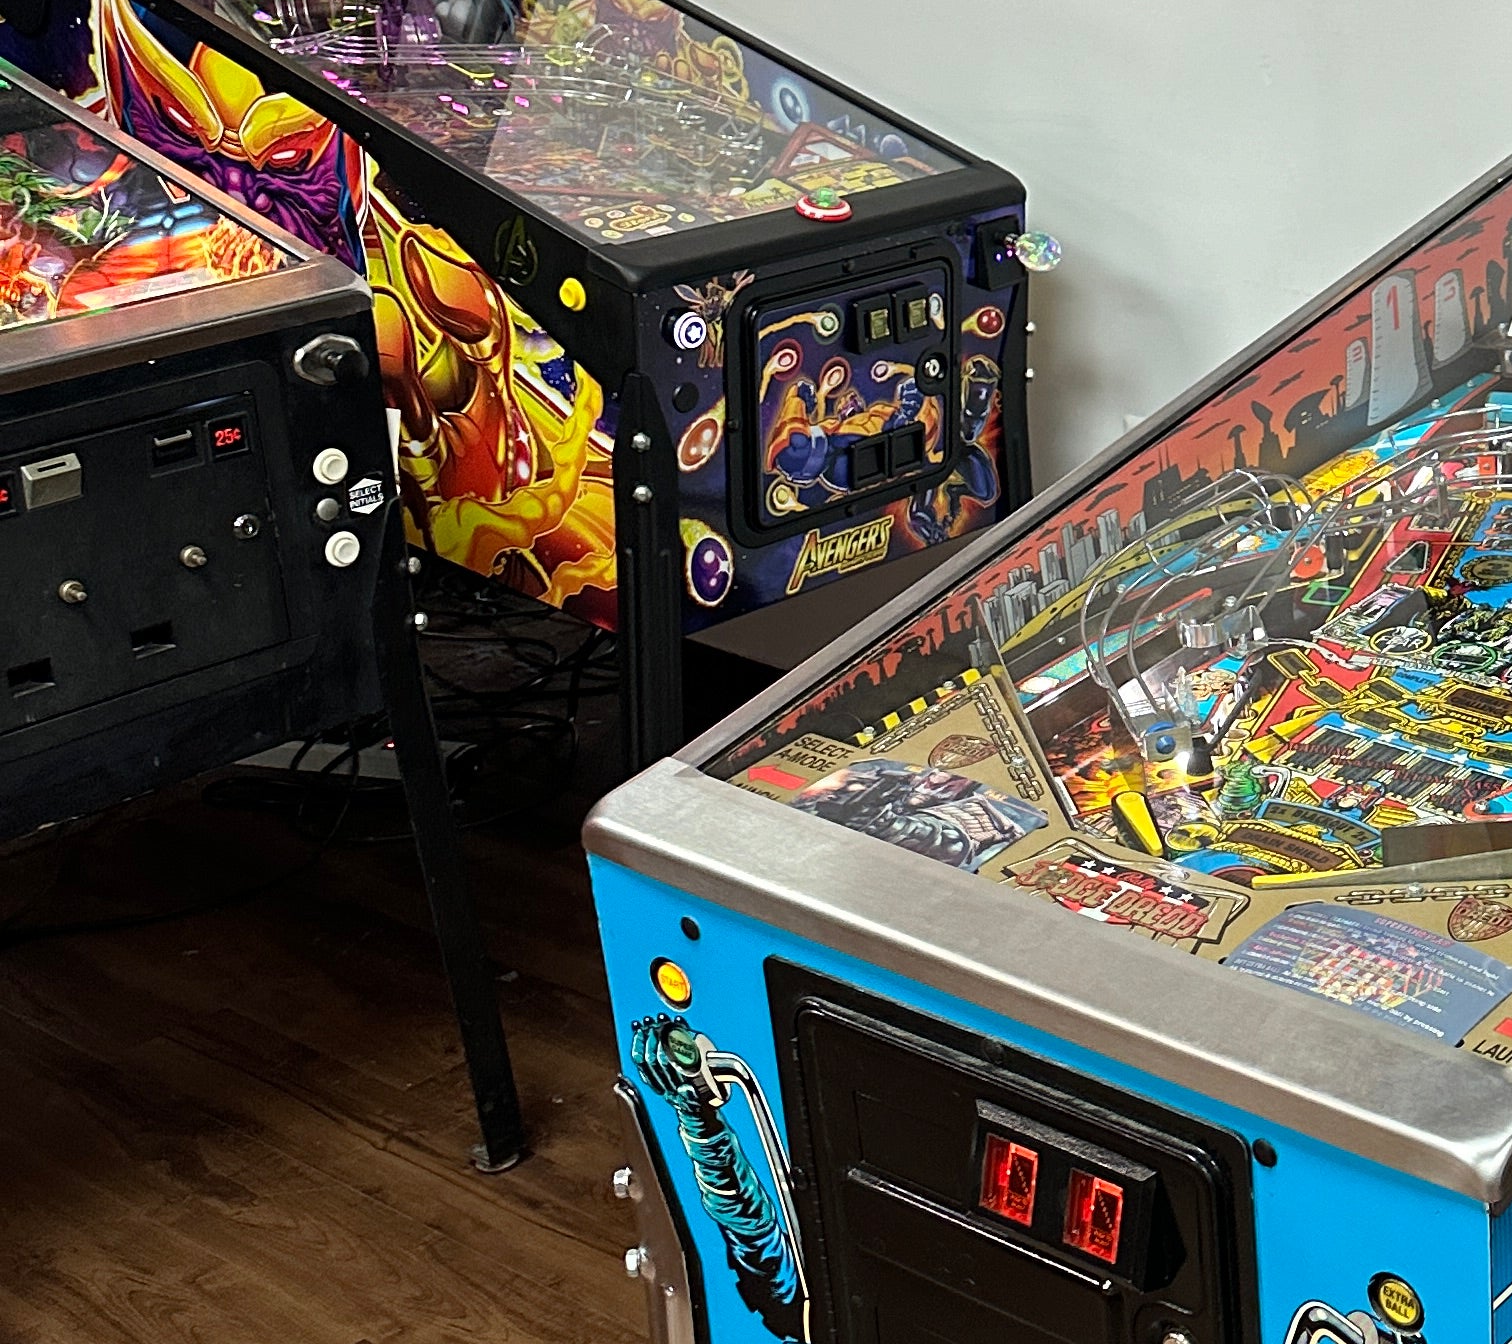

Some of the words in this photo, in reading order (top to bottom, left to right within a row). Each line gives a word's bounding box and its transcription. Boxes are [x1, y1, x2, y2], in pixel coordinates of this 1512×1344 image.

[214, 427, 242, 447] 25¢
[349, 483, 382, 500] SELECT
[788, 518, 892, 592] AVENGERS
[794, 736, 853, 760] SELECT
[776, 750, 837, 773] A-MODE
[1101, 889, 1209, 939] DREDD
[1383, 1285, 1415, 1309] EXTRA
[1385, 1298, 1410, 1320] BALL
